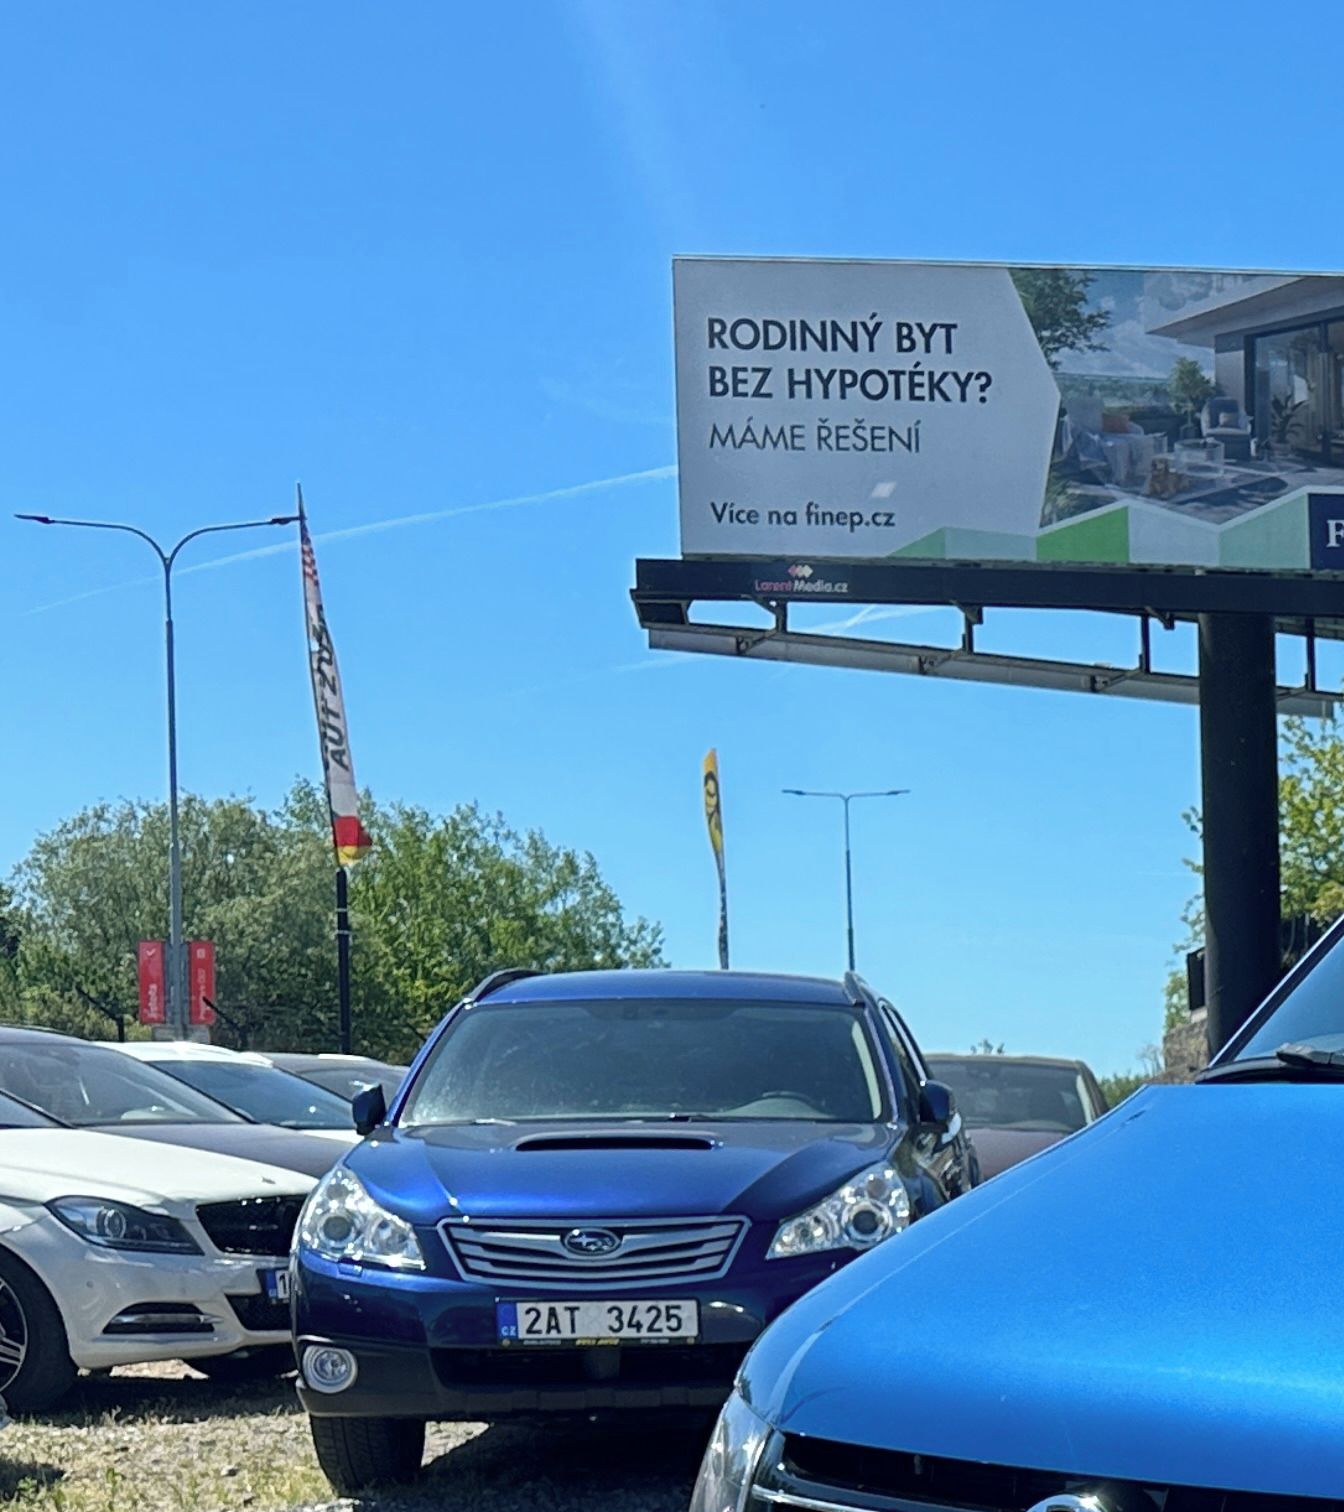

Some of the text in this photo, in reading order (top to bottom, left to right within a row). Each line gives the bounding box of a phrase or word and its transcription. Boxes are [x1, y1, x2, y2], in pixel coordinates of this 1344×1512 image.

[708, 312, 958, 354] RODINNÝ BYT
[709, 361, 992, 404] BEZ HYPOTÉKY?
[709, 416, 922, 453] MÁME ŘEŠENÍ
[710, 501, 896, 533] Více na finep.cz
[524, 1304, 684, 1335] 2AT 3425
